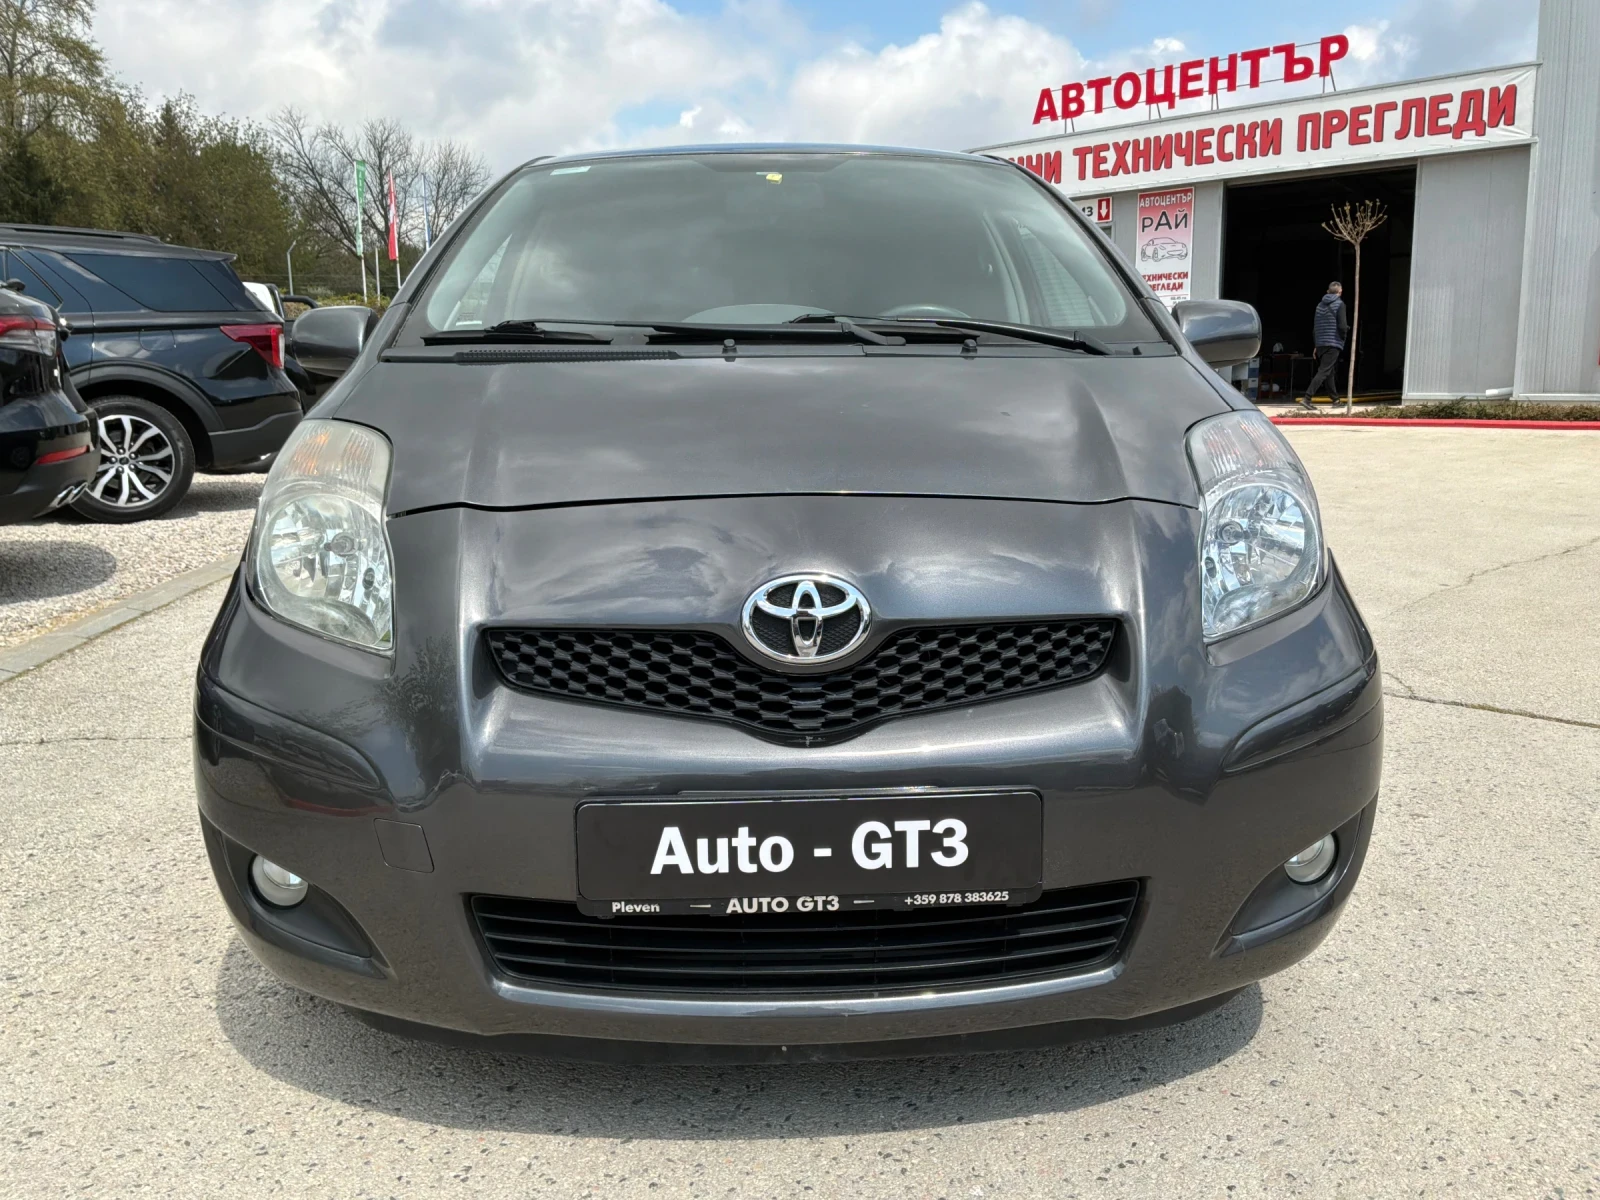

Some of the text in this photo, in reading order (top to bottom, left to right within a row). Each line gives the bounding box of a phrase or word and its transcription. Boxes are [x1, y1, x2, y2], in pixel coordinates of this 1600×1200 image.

[1032, 34, 1349, 125] АВТОЦЕНТЪР
[1008, 84, 1517, 185] НИ ТЕХНИЧЕСКИ ПРЕГЛЕДИ
[1139, 192, 1193, 208] АВТОЦЕНТЪР
[649, 826, 795, 875] Auto
[851, 818, 970, 870] GT3
[611, 890, 1010, 914] Pleven AUTO GT3 +359 878 383625
